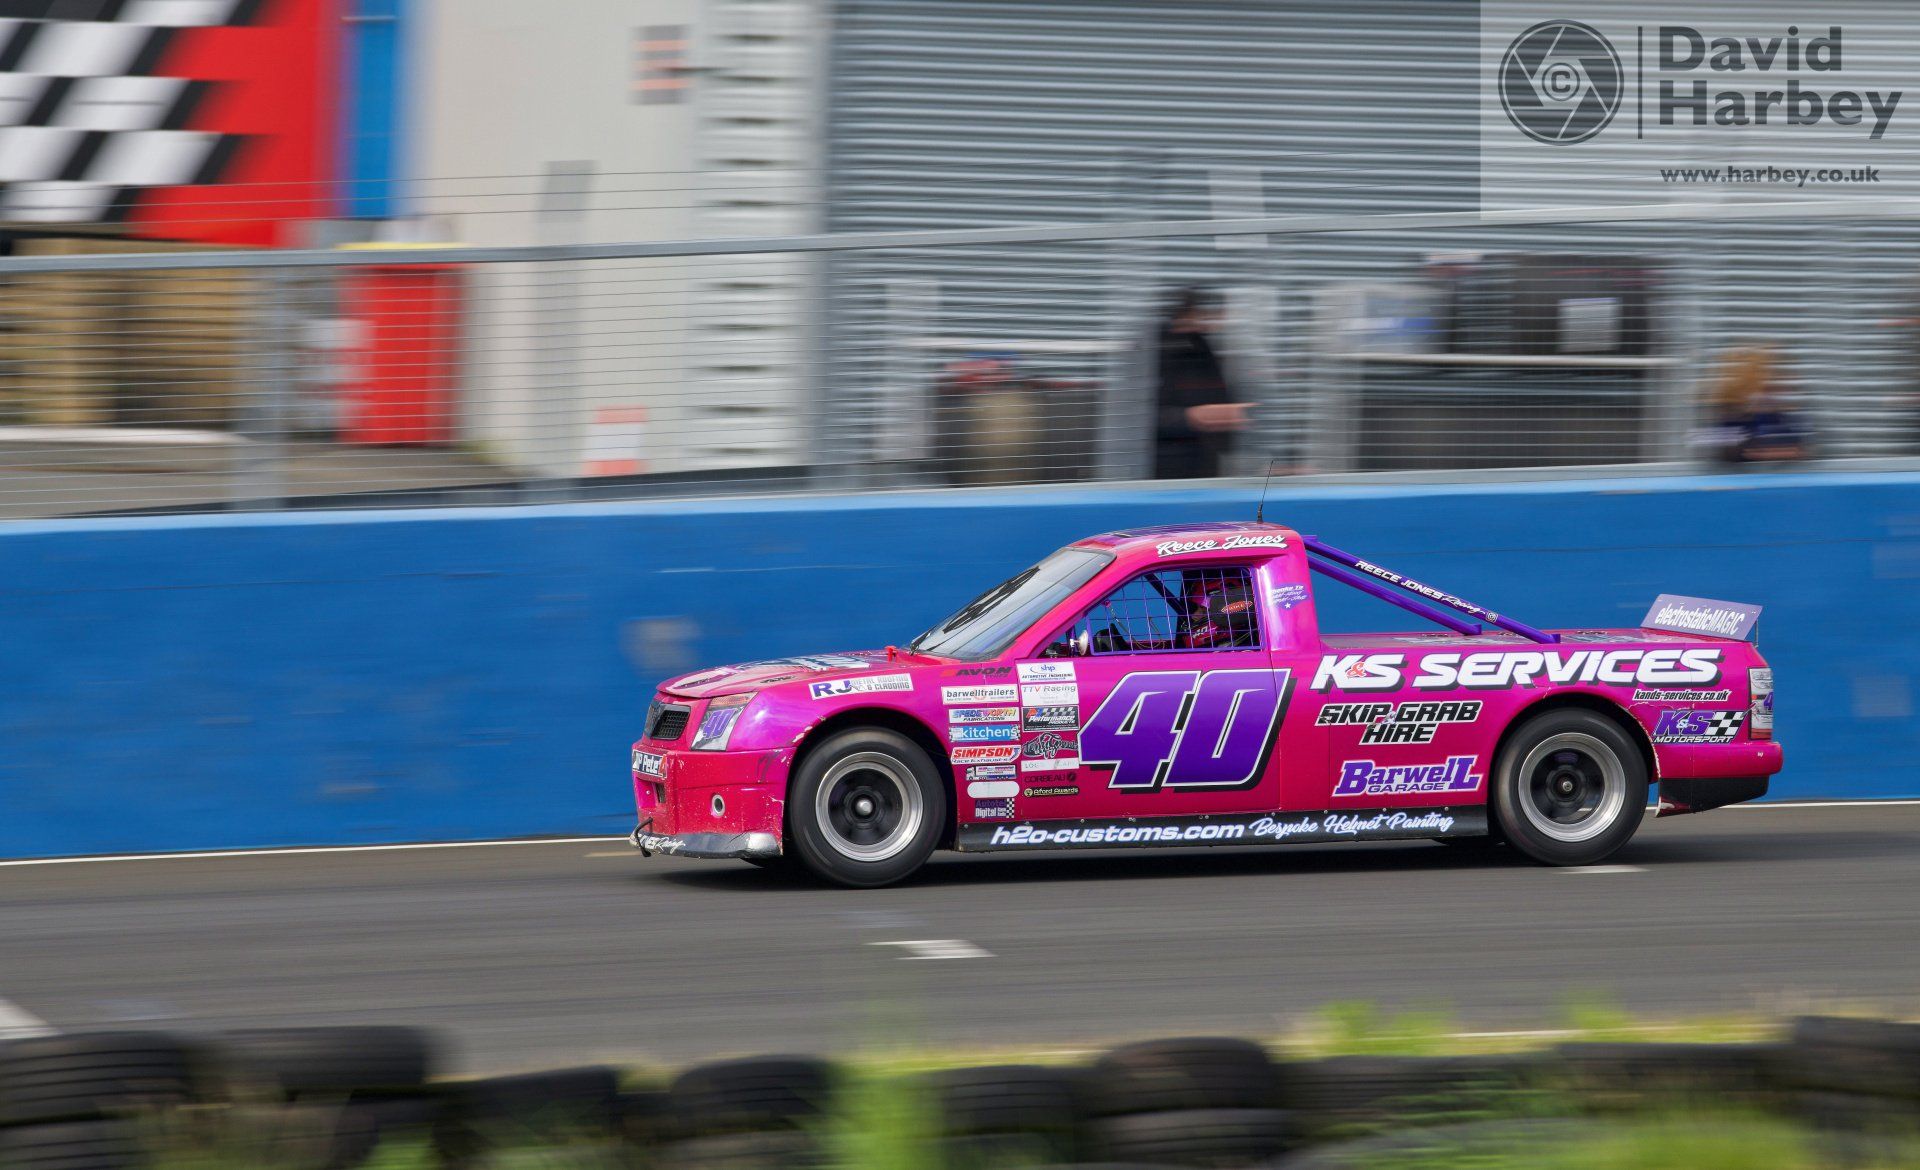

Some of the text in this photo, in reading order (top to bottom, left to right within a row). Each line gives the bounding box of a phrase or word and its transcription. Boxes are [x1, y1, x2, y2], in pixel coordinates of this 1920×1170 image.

[1156, 534, 1288, 557] Reece Jones
[1355, 560, 1403, 583] REECE
[1401, 579, 1446, 600] JONES
[1655, 603, 1746, 635] electrostaticMAGIC
[956, 666, 1012, 676] AVON
[1310, 648, 1722, 691] K&S SERVICES
[812, 680, 852, 697] RJ
[946, 688, 1015, 698] barwelltrailers
[1043, 685, 1077, 693] Racing
[1633, 688, 1732, 701] kands-services.co.uk
[952, 708, 1017, 719] SPEDEWORTH
[1028, 715, 1076, 723] Performance
[1317, 702, 1394, 726] SKIP
[1395, 700, 1483, 724] GRAB
[1077, 668, 1294, 791] 40
[1653, 709, 1718, 737] K&S
[961, 726, 1018, 738] kitchens
[1359, 722, 1438, 745] HIRE
[1653, 735, 1735, 744] MOTORSPORT
[953, 747, 1013, 758] SIMPSON
[1367, 782, 1446, 794] GARAGE
[975, 808, 997, 818] Digital
[1248, 811, 1455, 840] Bespoke Helmet Painting
[990, 823, 1246, 845] h2o-customs.com
